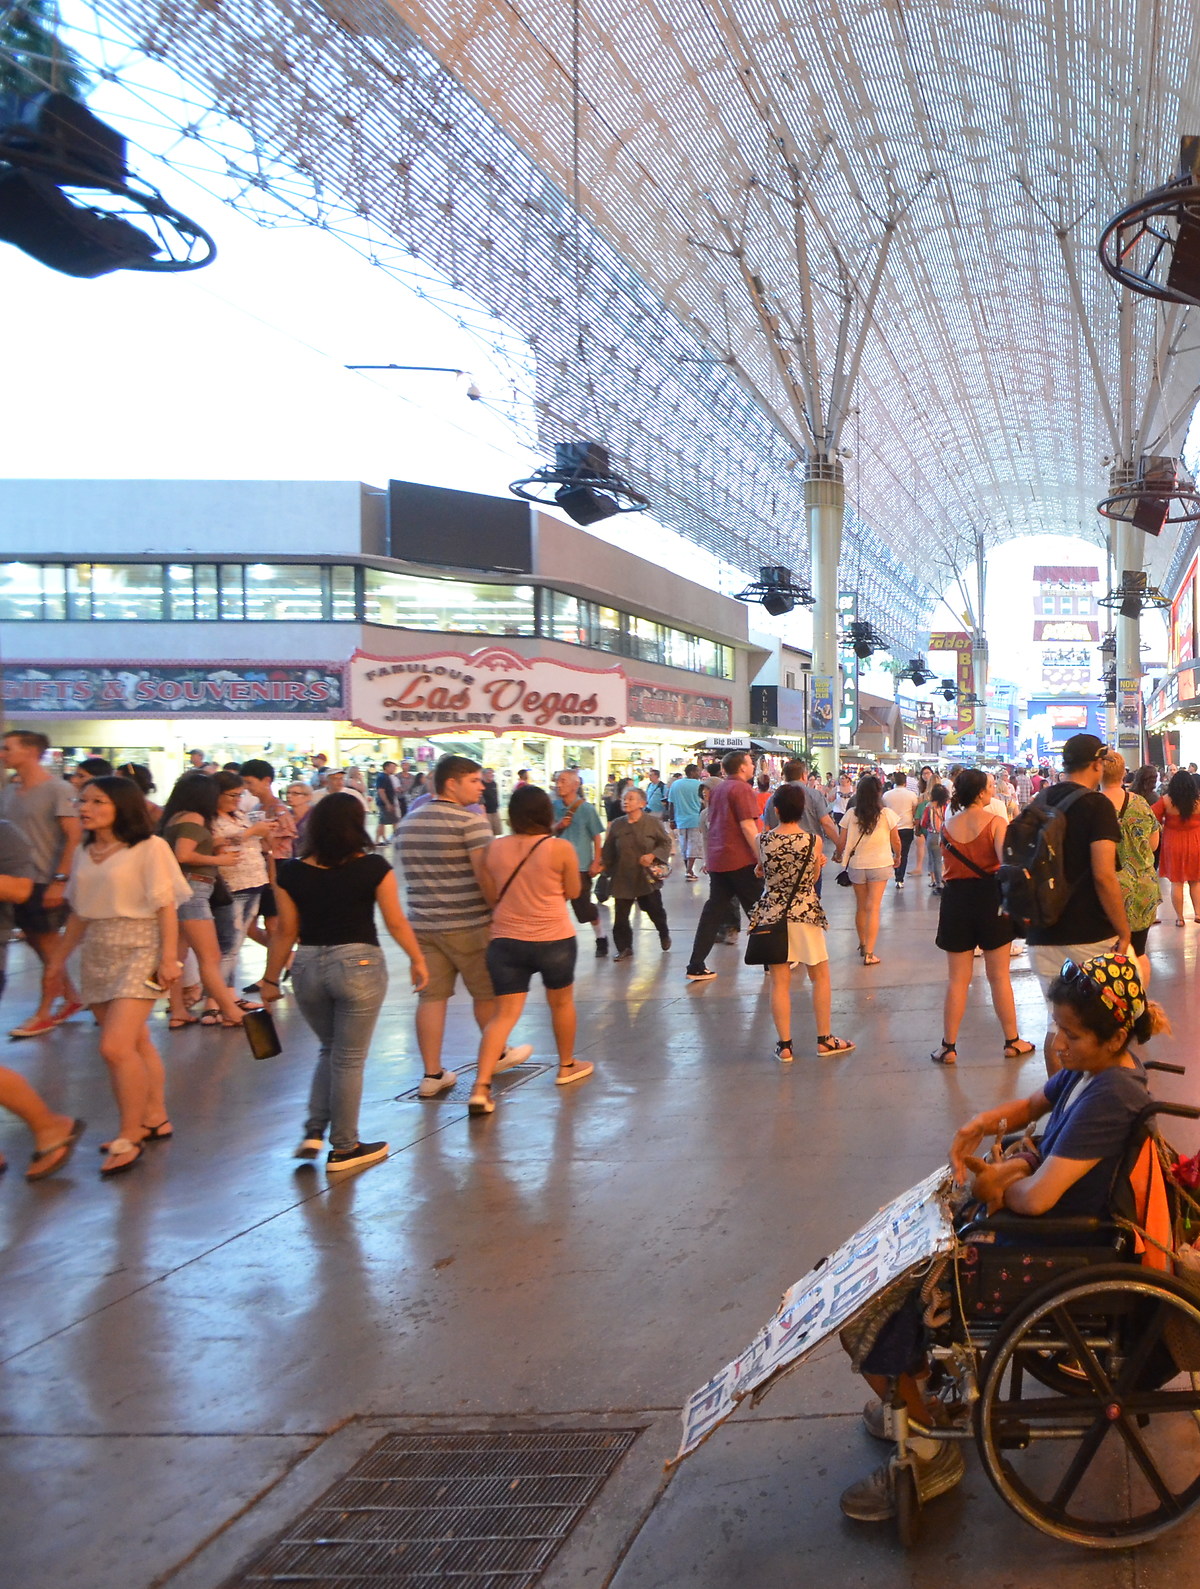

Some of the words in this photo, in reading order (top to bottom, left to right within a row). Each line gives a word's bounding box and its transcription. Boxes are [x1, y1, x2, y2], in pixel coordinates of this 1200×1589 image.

[929, 634, 971, 649] rader
[366, 664, 475, 686] FABULOUS
[103, 680, 127, 700] &
[136, 680, 330, 700] SOUVENIRS
[1120, 680, 1138, 688] NOW
[382, 675, 472, 709] Las
[484, 680, 598, 726] Vegas
[385, 711, 495, 723] JEWELRY
[509, 714, 524, 725] &
[559, 714, 617, 727] GIFTS
[713, 738, 725, 746] Big
[727, 738, 743, 746] Balls
